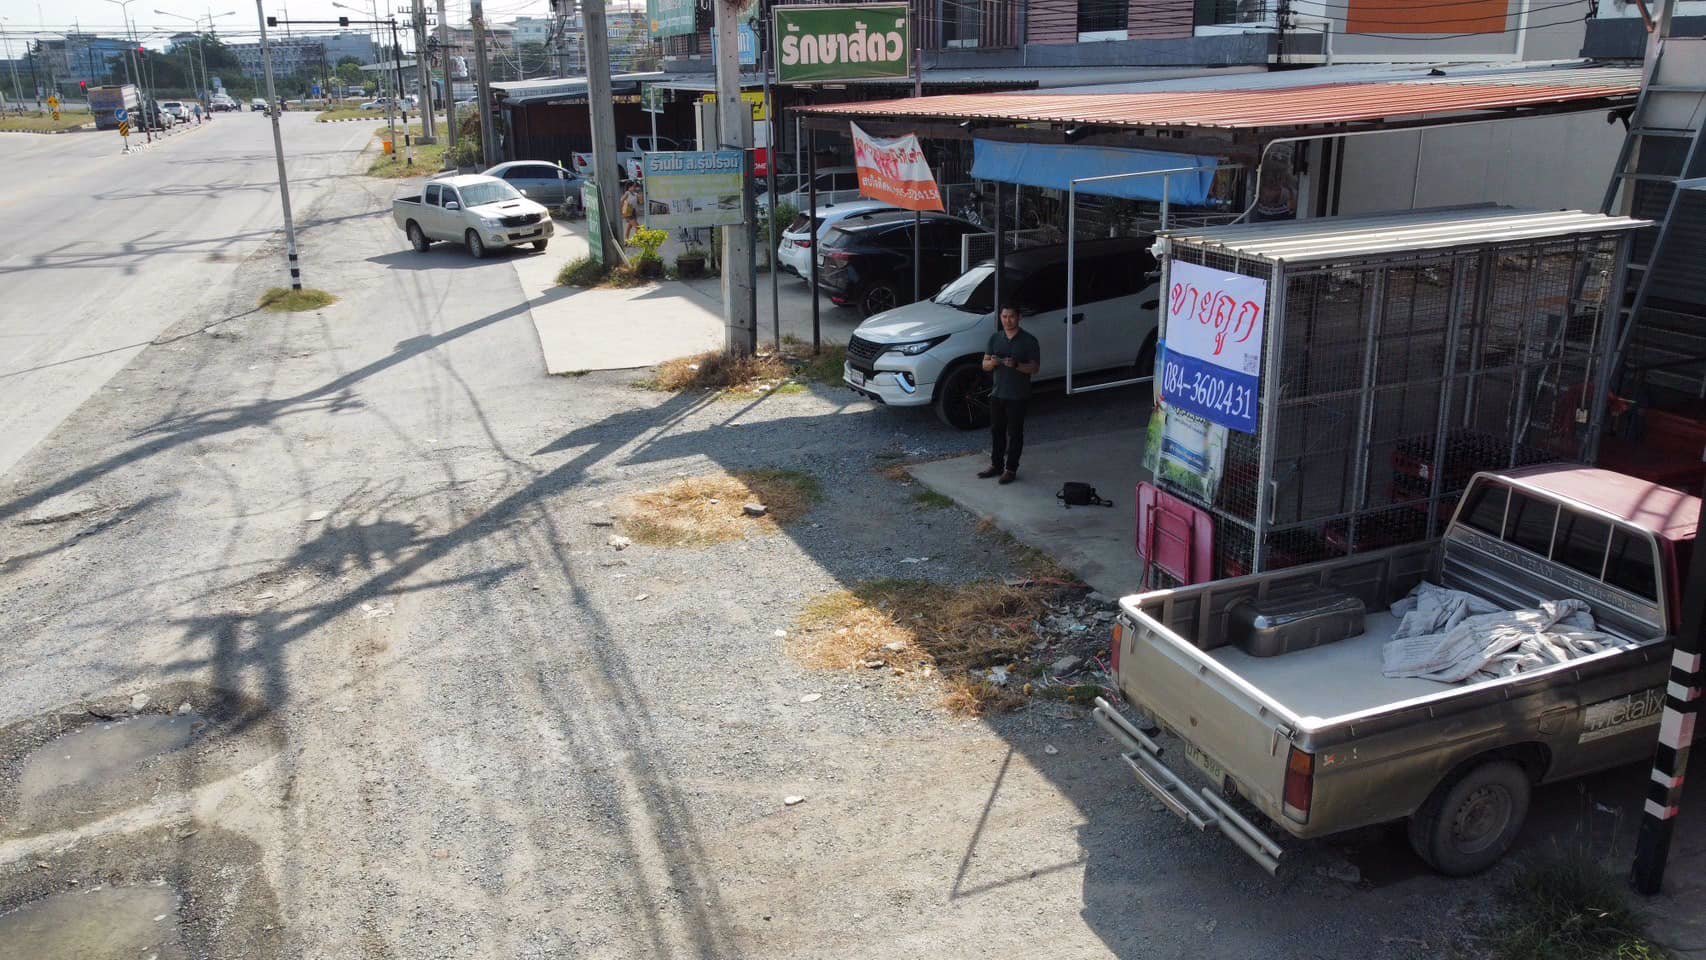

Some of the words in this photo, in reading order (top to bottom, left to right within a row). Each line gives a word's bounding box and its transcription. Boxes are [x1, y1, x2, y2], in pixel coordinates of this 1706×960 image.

[782, 18, 904, 66] รักษาสัตว์
[1172, 282, 1260, 356] ขายถูก
[1164, 361, 1252, 419] 084-3602431
